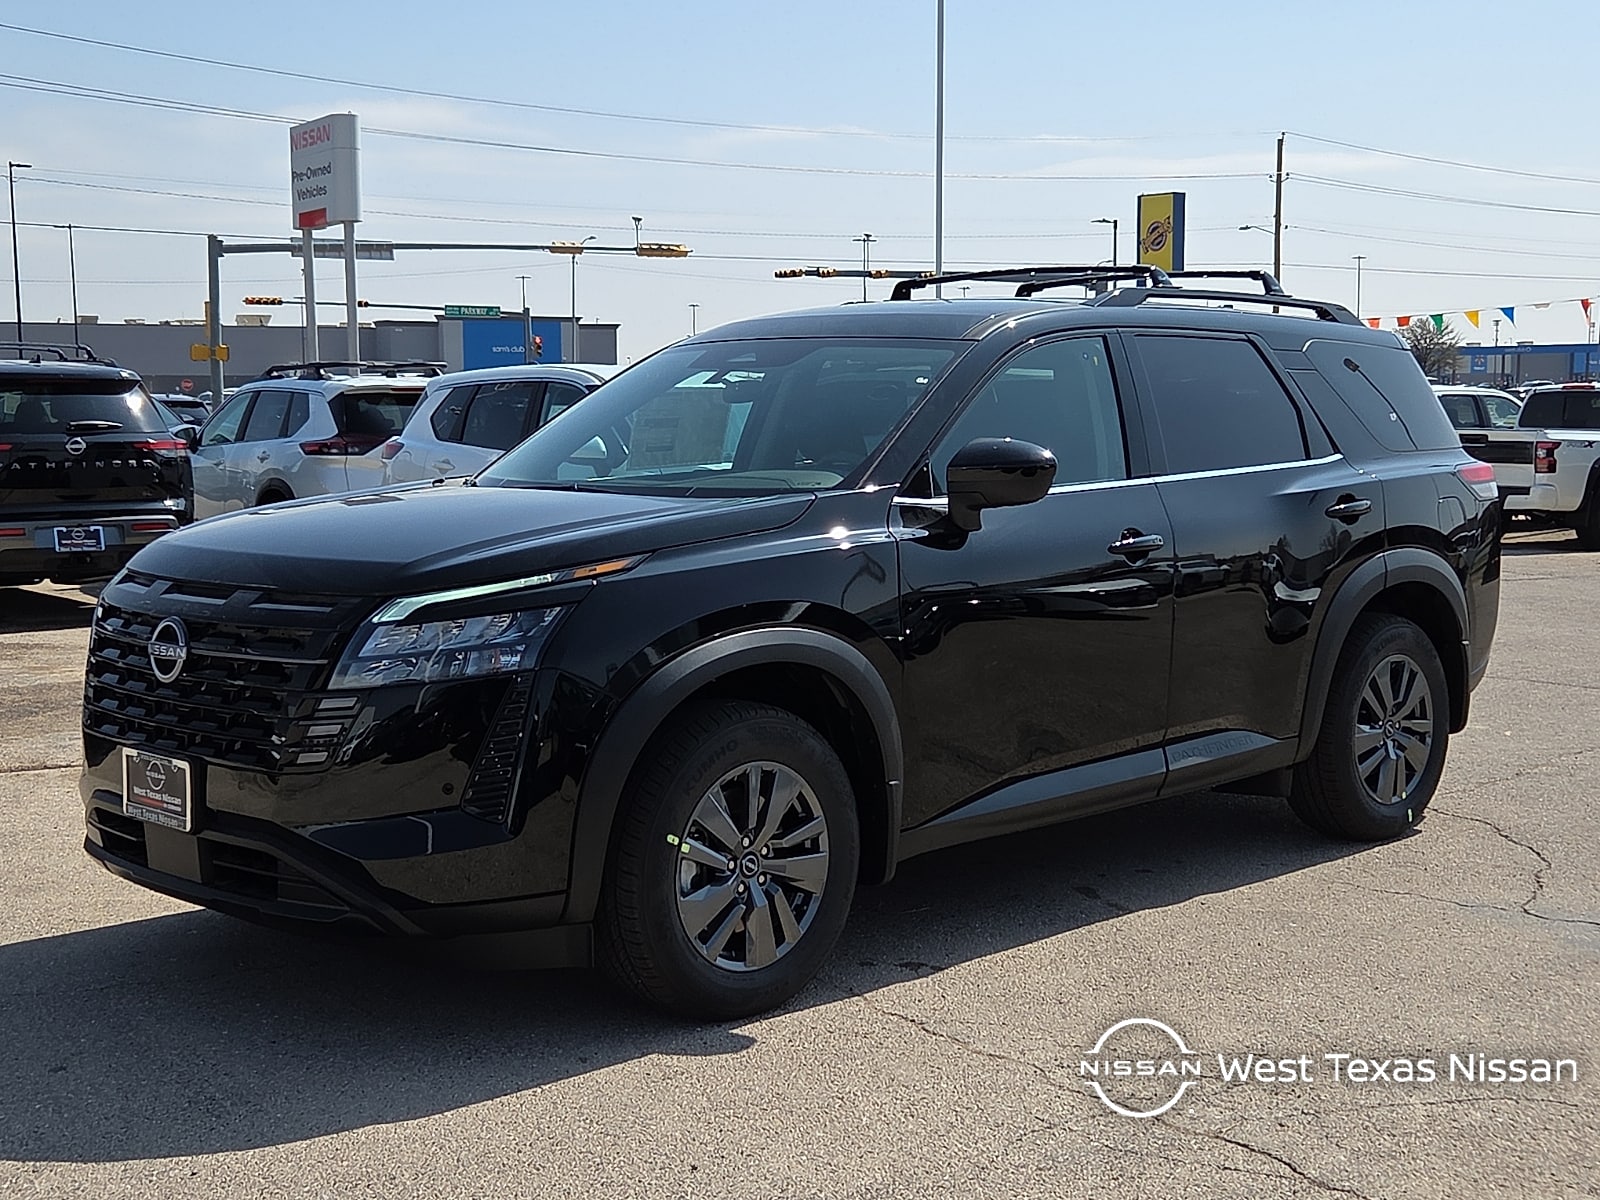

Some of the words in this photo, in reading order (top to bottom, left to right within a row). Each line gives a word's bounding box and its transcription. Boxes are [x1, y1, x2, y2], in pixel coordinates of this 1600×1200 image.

[292, 123, 331, 150] NISSAN
[292, 162, 332, 183] Pre-Owned
[296, 184, 328, 201] Vehicles
[150, 644, 187, 658] SSAN
[1172, 735, 1252, 762] PATHFINDER
[133, 785, 146, 798] West
[147, 788, 162, 801] Texas
[162, 792, 182, 806] Nissan
